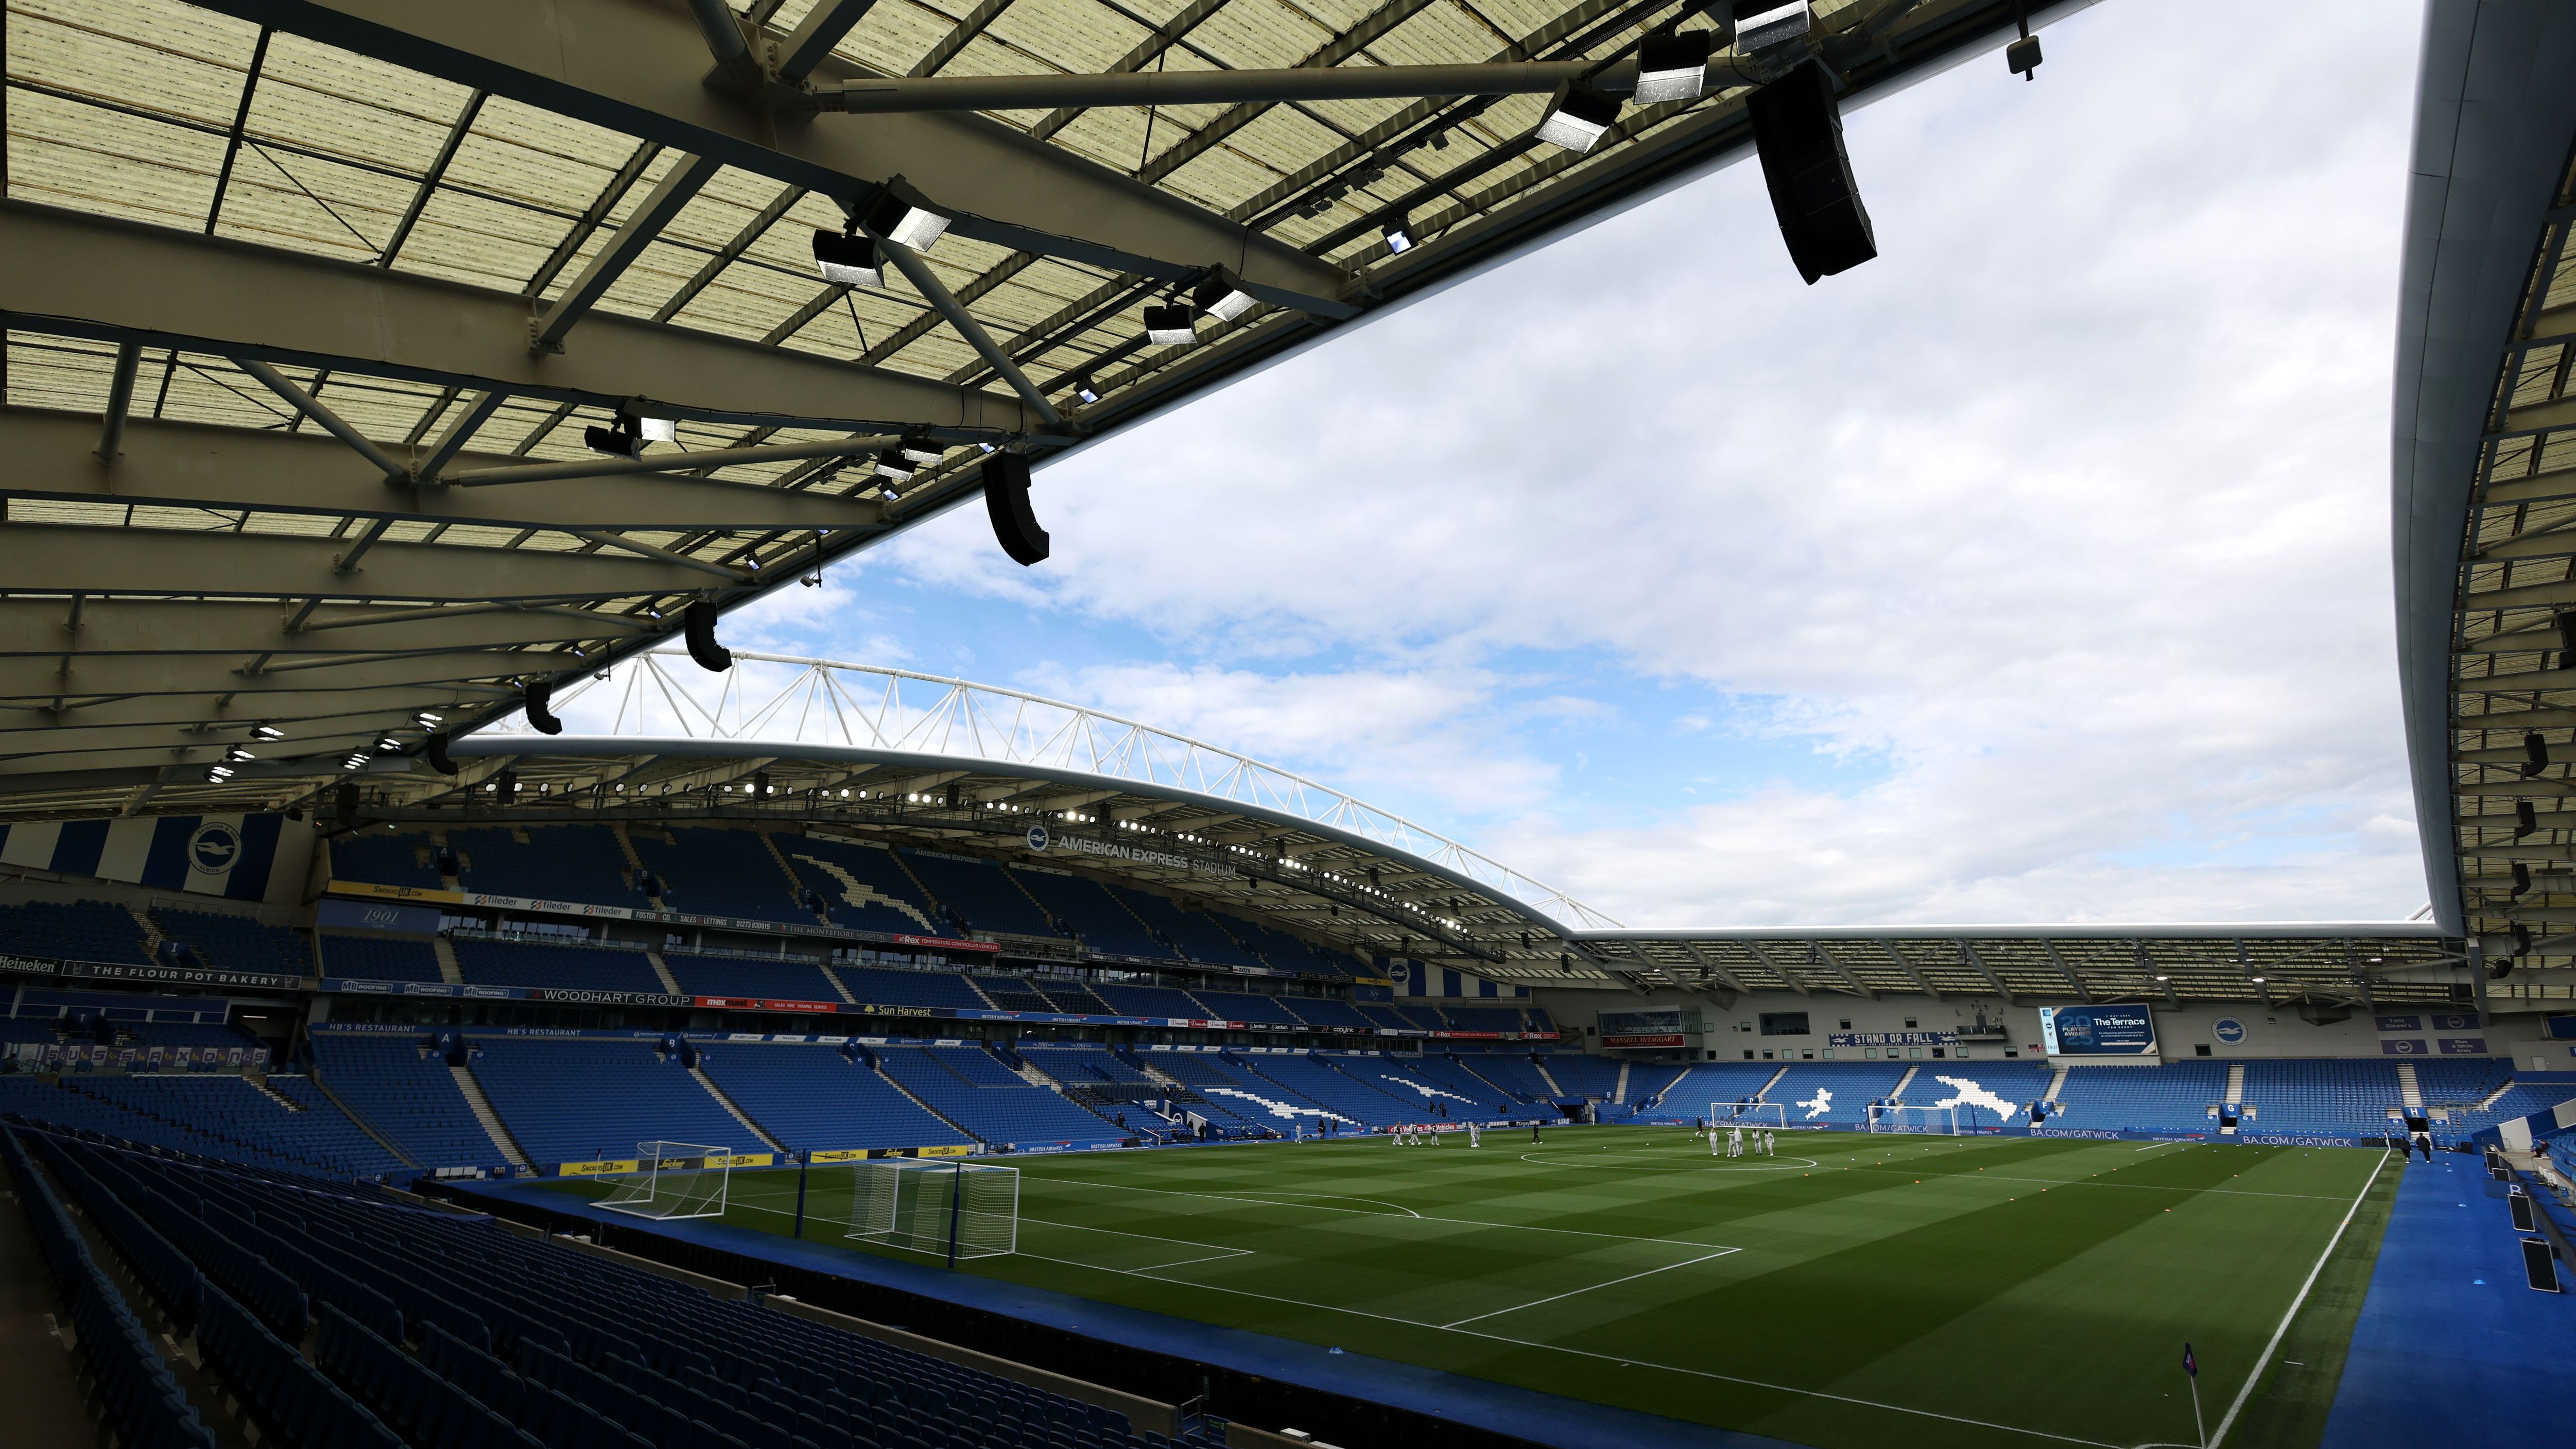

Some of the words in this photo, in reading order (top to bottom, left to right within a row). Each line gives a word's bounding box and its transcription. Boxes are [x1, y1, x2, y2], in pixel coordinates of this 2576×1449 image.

[440, 847, 447, 855] A
[1058, 836, 1129, 859] AMERICAN
[1132, 848, 1188, 868] EXPRESS
[1192, 859, 1236, 876] STADIUM
[915, 850, 950, 859] AMERICAN
[952, 855, 981, 864] EXPRESS
[488, 895, 517, 906] fileder
[543, 901, 570, 911] fileder
[364, 910, 400, 923] 1901
[595, 907, 621, 916] fileder
[636, 911, 656, 920] FOSTER
[680, 915, 696, 923] SALES
[703, 918, 727, 926] LETTINGS
[807, 928, 854, 938] MONTEFIORE
[856, 933, 886, 941] HOSPITAL
[905, 935, 920, 944] Rex
[0, 956, 54, 973] Heineken
[93, 966, 122, 975] THE
[129, 969, 178, 979] FLOUR
[185, 972, 213, 981] POT
[219, 974, 278, 985] BAKERY
[343, 981, 356, 990] MB
[406, 984, 419, 993] MB
[464, 987, 477, 996] MB
[545, 990, 631, 1003] WOODHART
[635, 994, 690, 1006] GROUP
[707, 998, 748, 1007] mexmast
[878, 1006, 894, 1014] Sun
[897, 1007, 931, 1016] Harvest
[442, 1033, 449, 1042] A
[1854, 1034, 1885, 1044] STAND
[1890, 1033, 1902, 1043] OR
[1907, 1033, 1933, 1043] FALL
[2031, 1129, 2119, 1140] BA.COM/GATWICK
[2243, 1136, 2352, 1147] BA.COM/GATWICK
